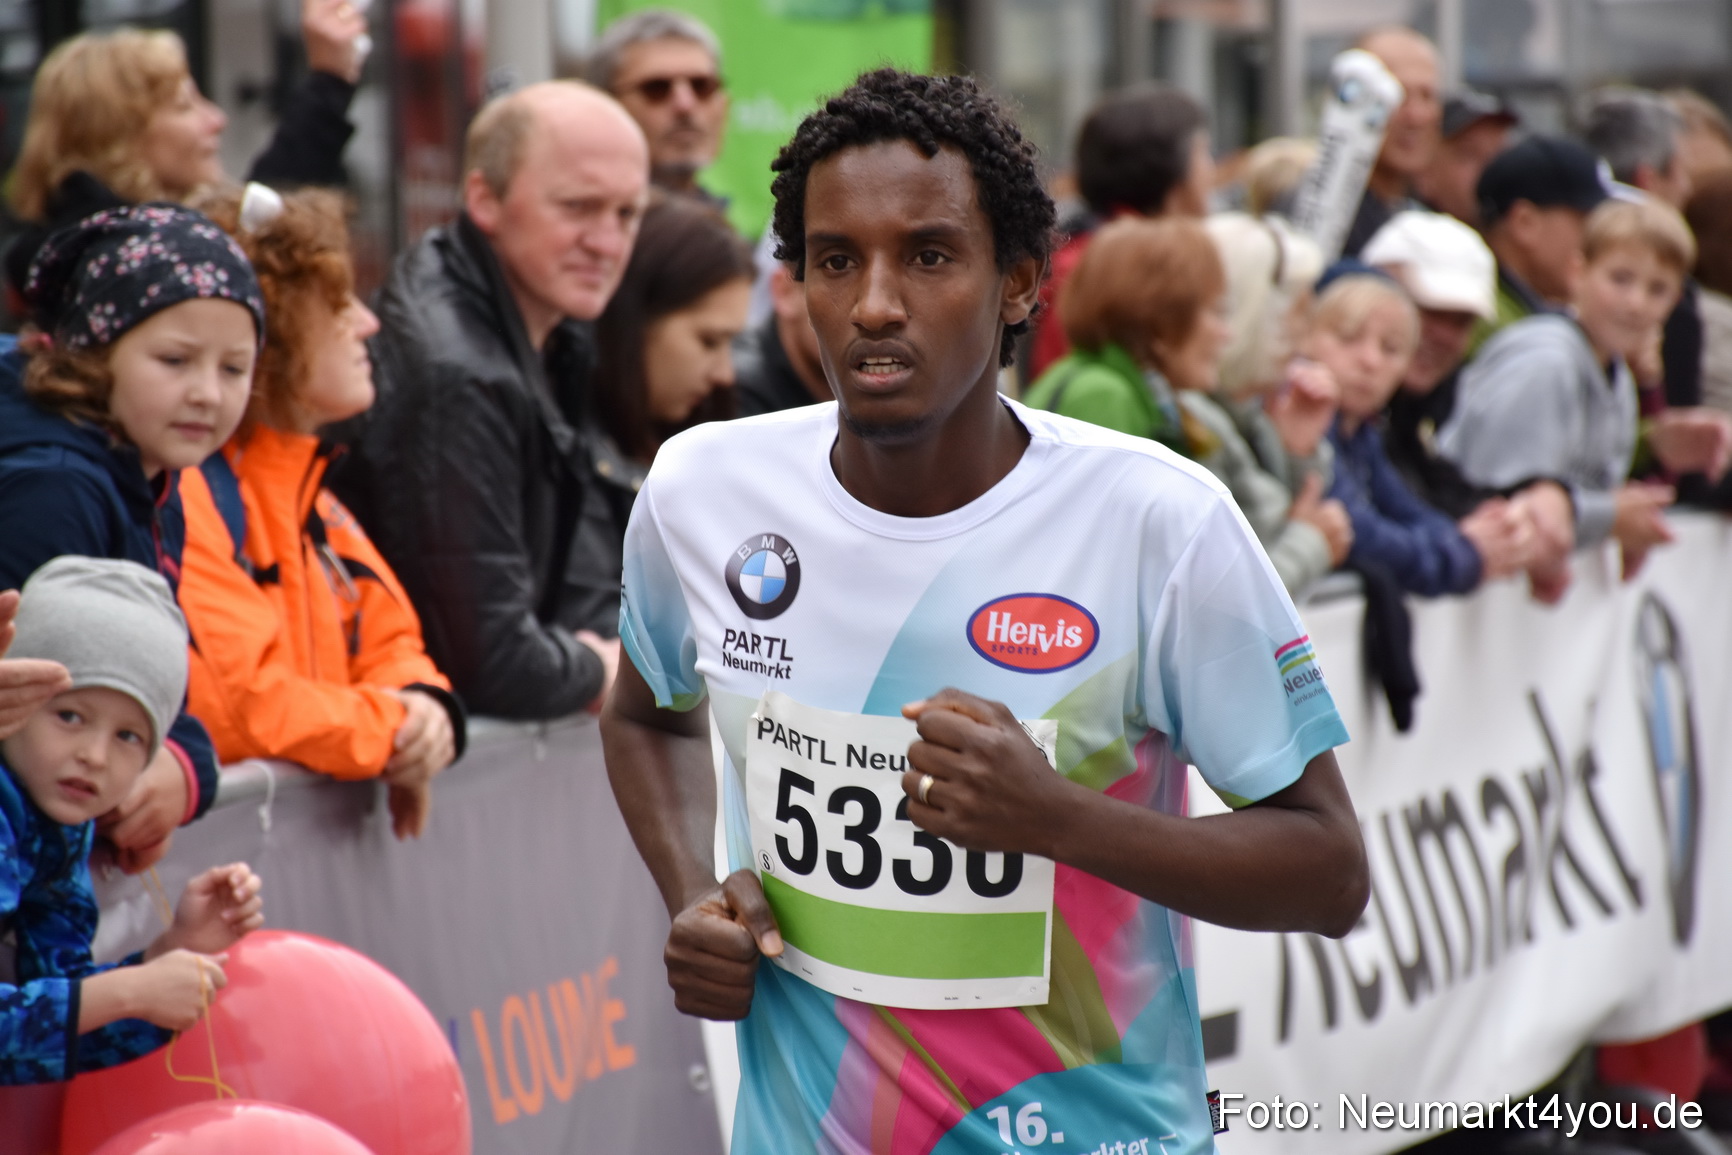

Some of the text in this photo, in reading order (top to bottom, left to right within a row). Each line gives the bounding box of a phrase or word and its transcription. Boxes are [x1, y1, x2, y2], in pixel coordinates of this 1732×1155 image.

[737, 535, 797, 567] BMW
[722, 628, 794, 662] PARTL
[986, 611, 1083, 653] Hervis
[991, 644, 1039, 656] SPORTS
[757, 717, 911, 773] PARTL Neu
[986, 1102, 1064, 1147] 16.
